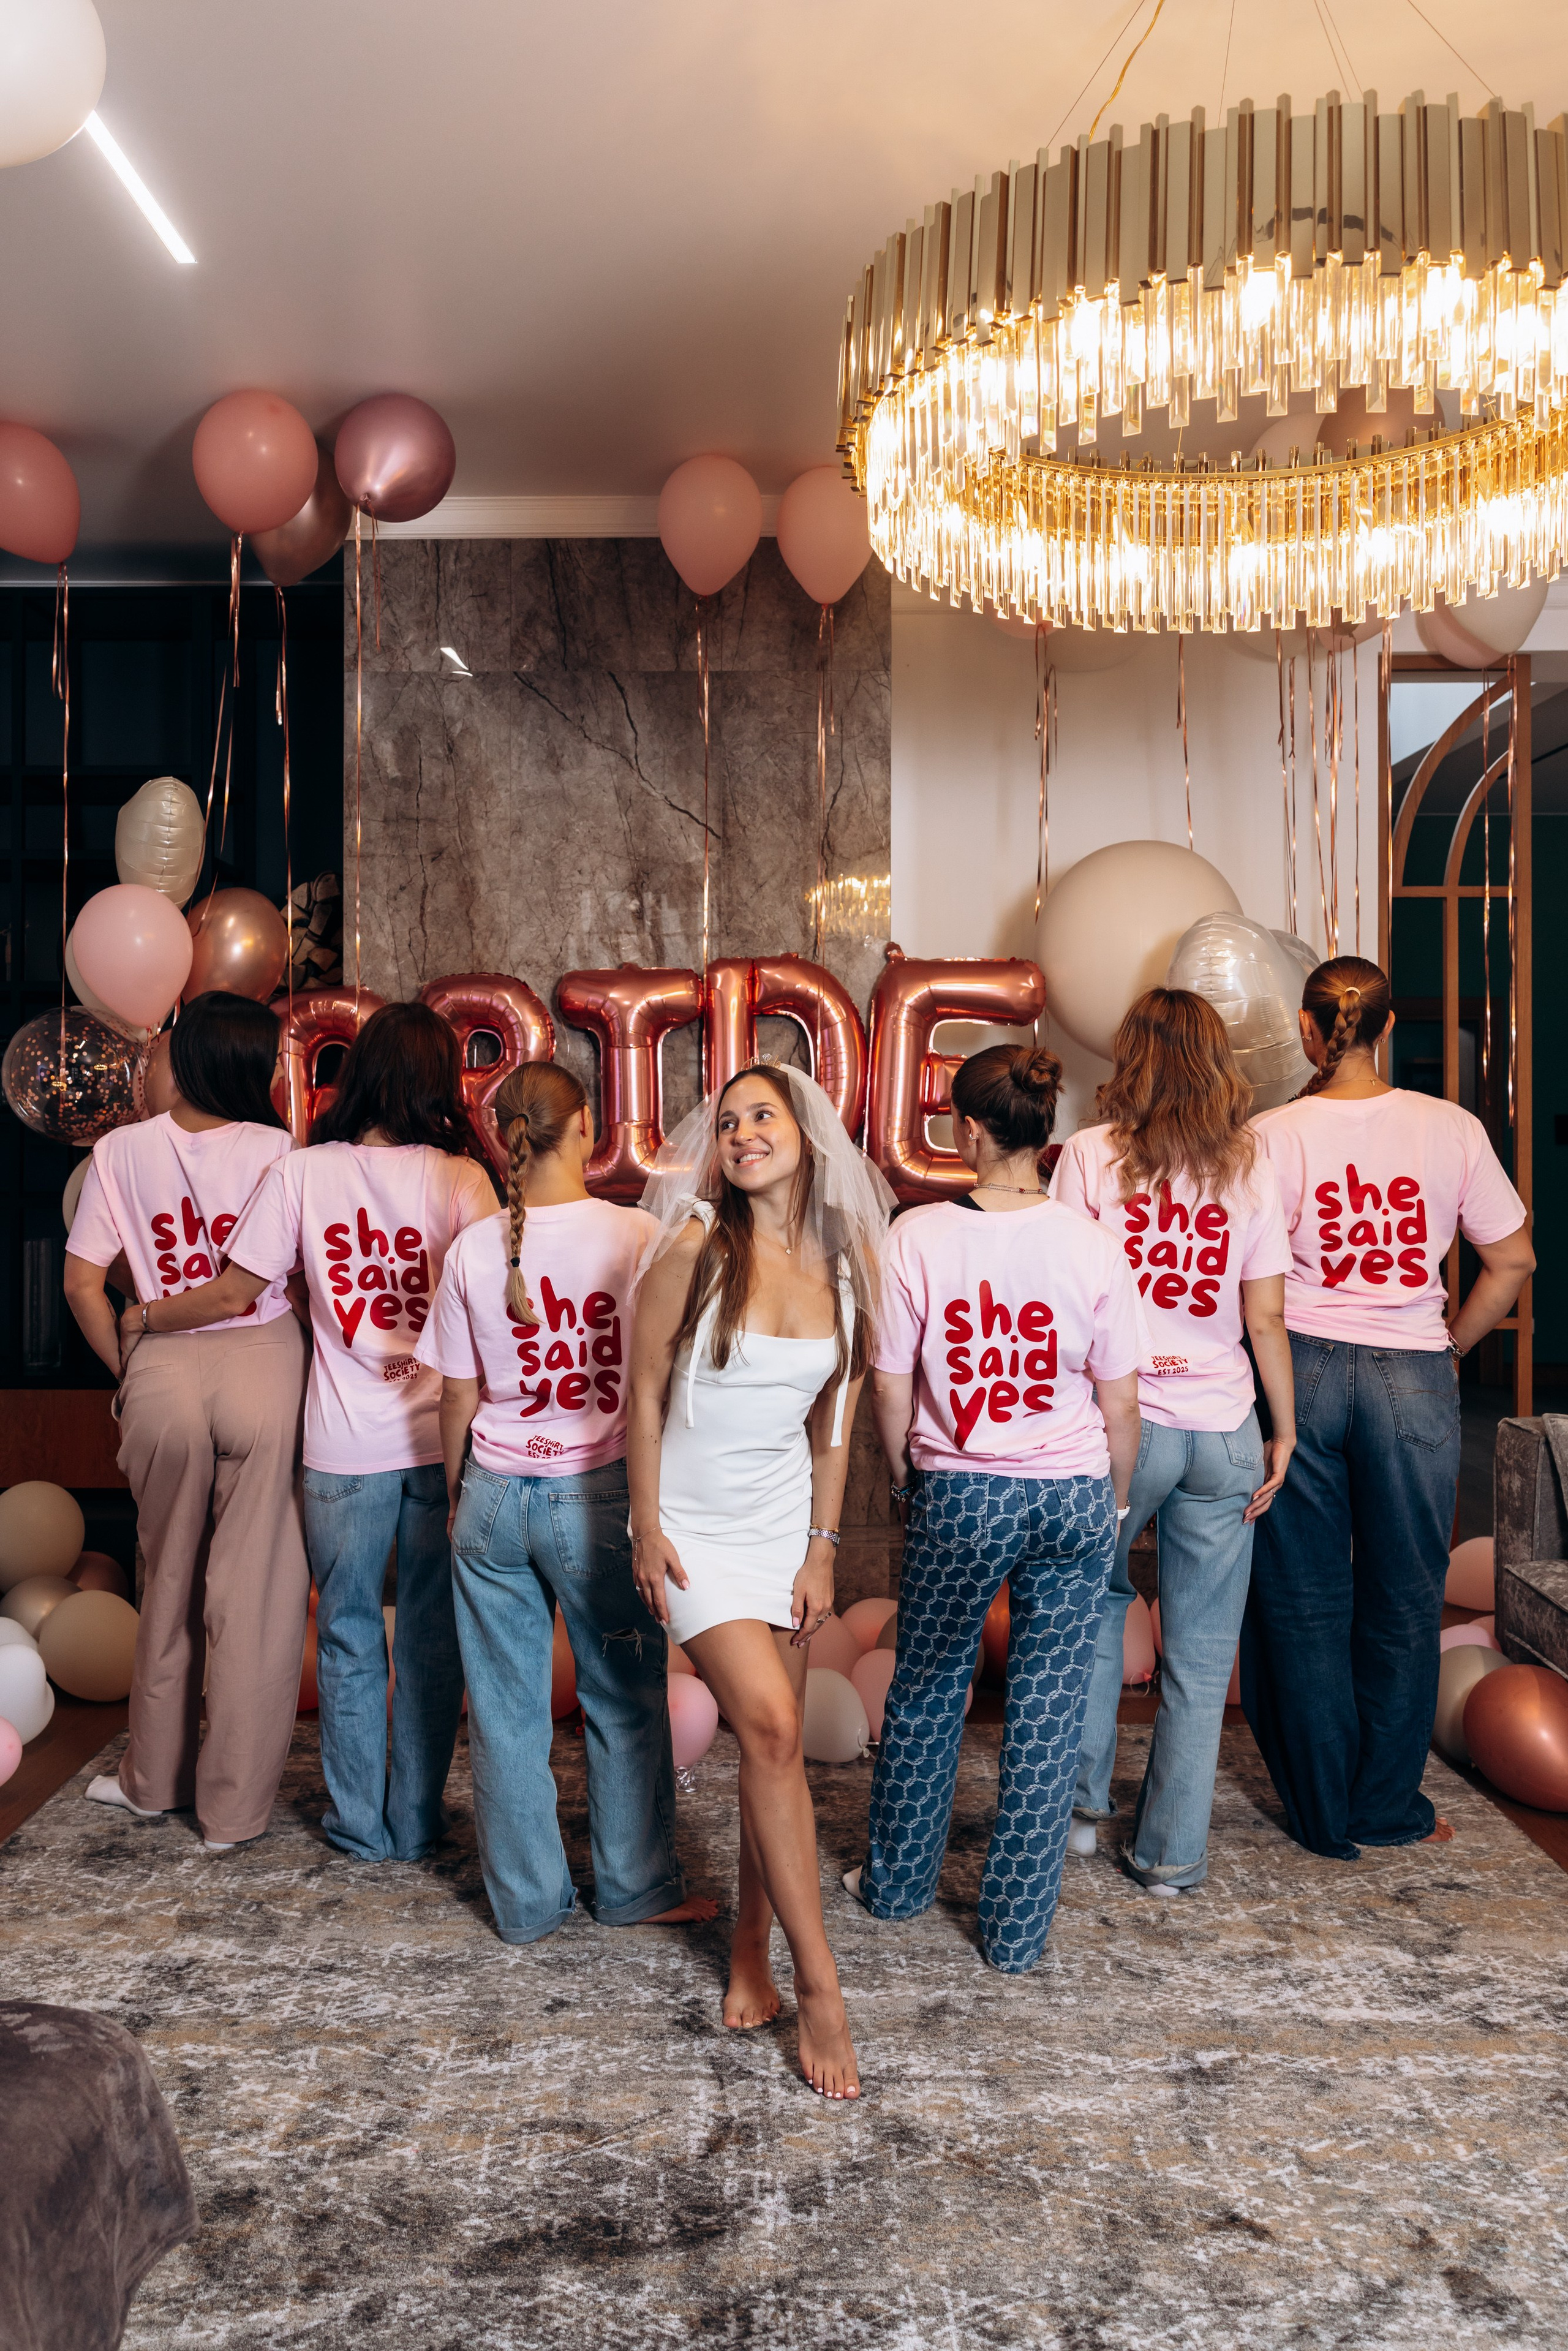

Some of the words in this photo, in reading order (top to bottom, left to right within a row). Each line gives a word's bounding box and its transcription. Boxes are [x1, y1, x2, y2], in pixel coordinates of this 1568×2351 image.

[1123, 1176, 1229, 1241] she
[1314, 1163, 1420, 1220] she
[323, 1207, 423, 1262] she
[1123, 1229, 1230, 1276] said
[1319, 1198, 1428, 1253] said
[328, 1249, 430, 1296] said
[1321, 1247, 1428, 1289] yes
[333, 1293, 429, 1349] yes
[506, 1275, 617, 1340] she
[944, 1280, 1054, 1345] she
[517, 1315, 622, 1377] said
[946, 1329, 1058, 1385] said
[519, 1369, 621, 1417] yes
[949, 1380, 1055, 1451] yes
